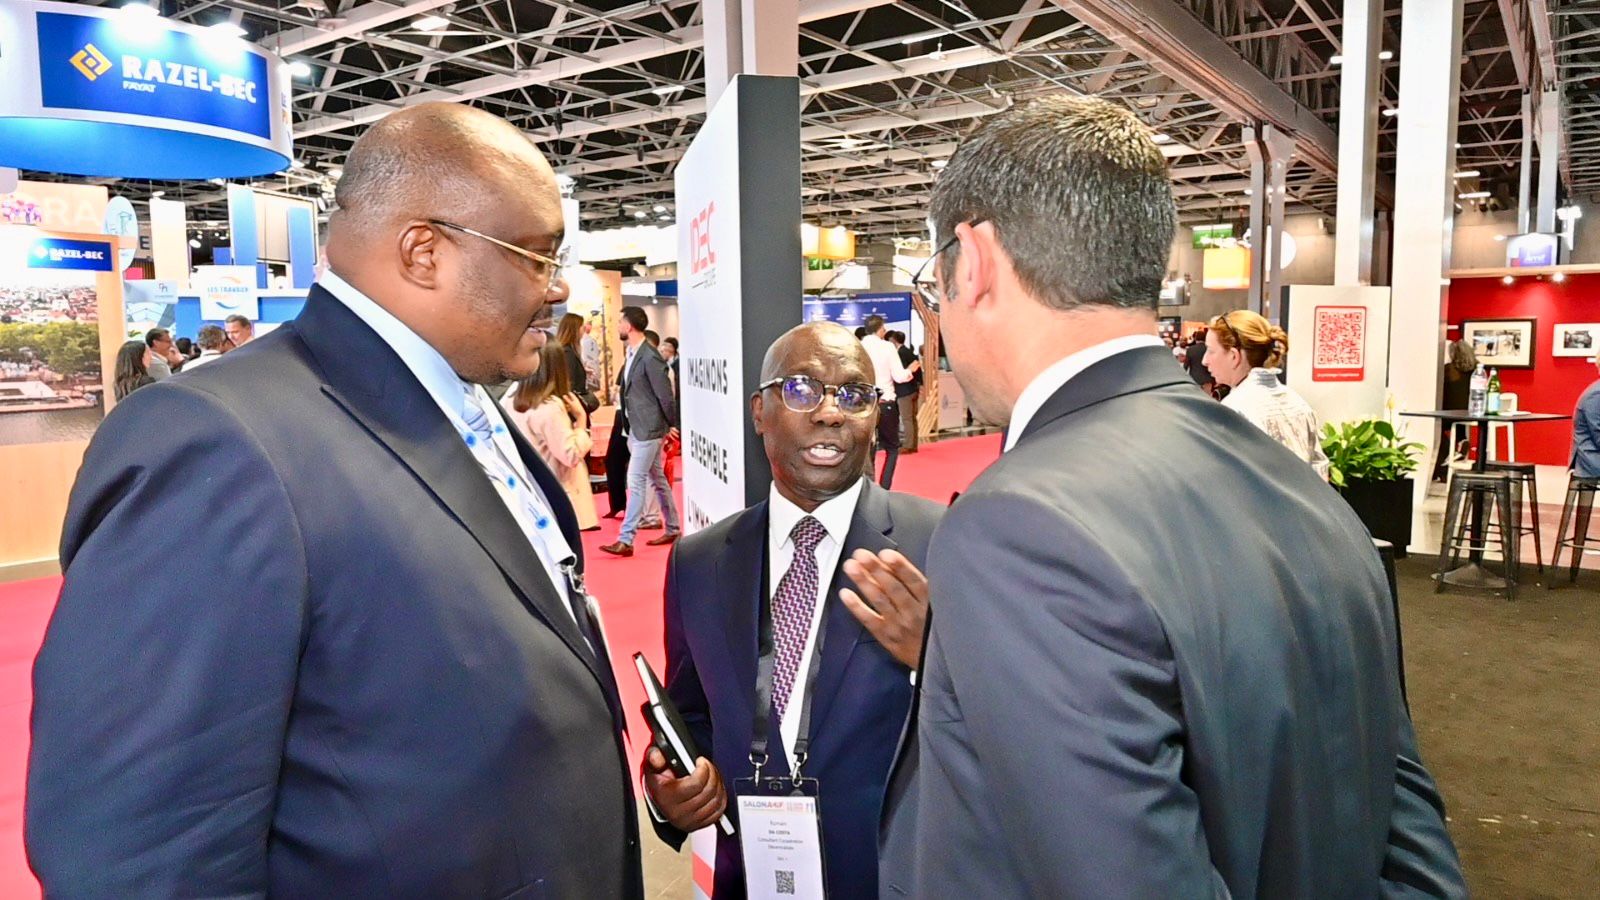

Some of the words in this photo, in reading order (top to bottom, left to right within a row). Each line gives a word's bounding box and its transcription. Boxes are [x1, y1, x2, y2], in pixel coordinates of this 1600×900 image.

[121, 54, 257, 104] RAZEL-BEC
[122, 80, 156, 92] FAYAT
[690, 201, 715, 275] IDEC
[687, 358, 728, 395] IMAGINONS
[691, 430, 728, 484] ENSEMBLE
